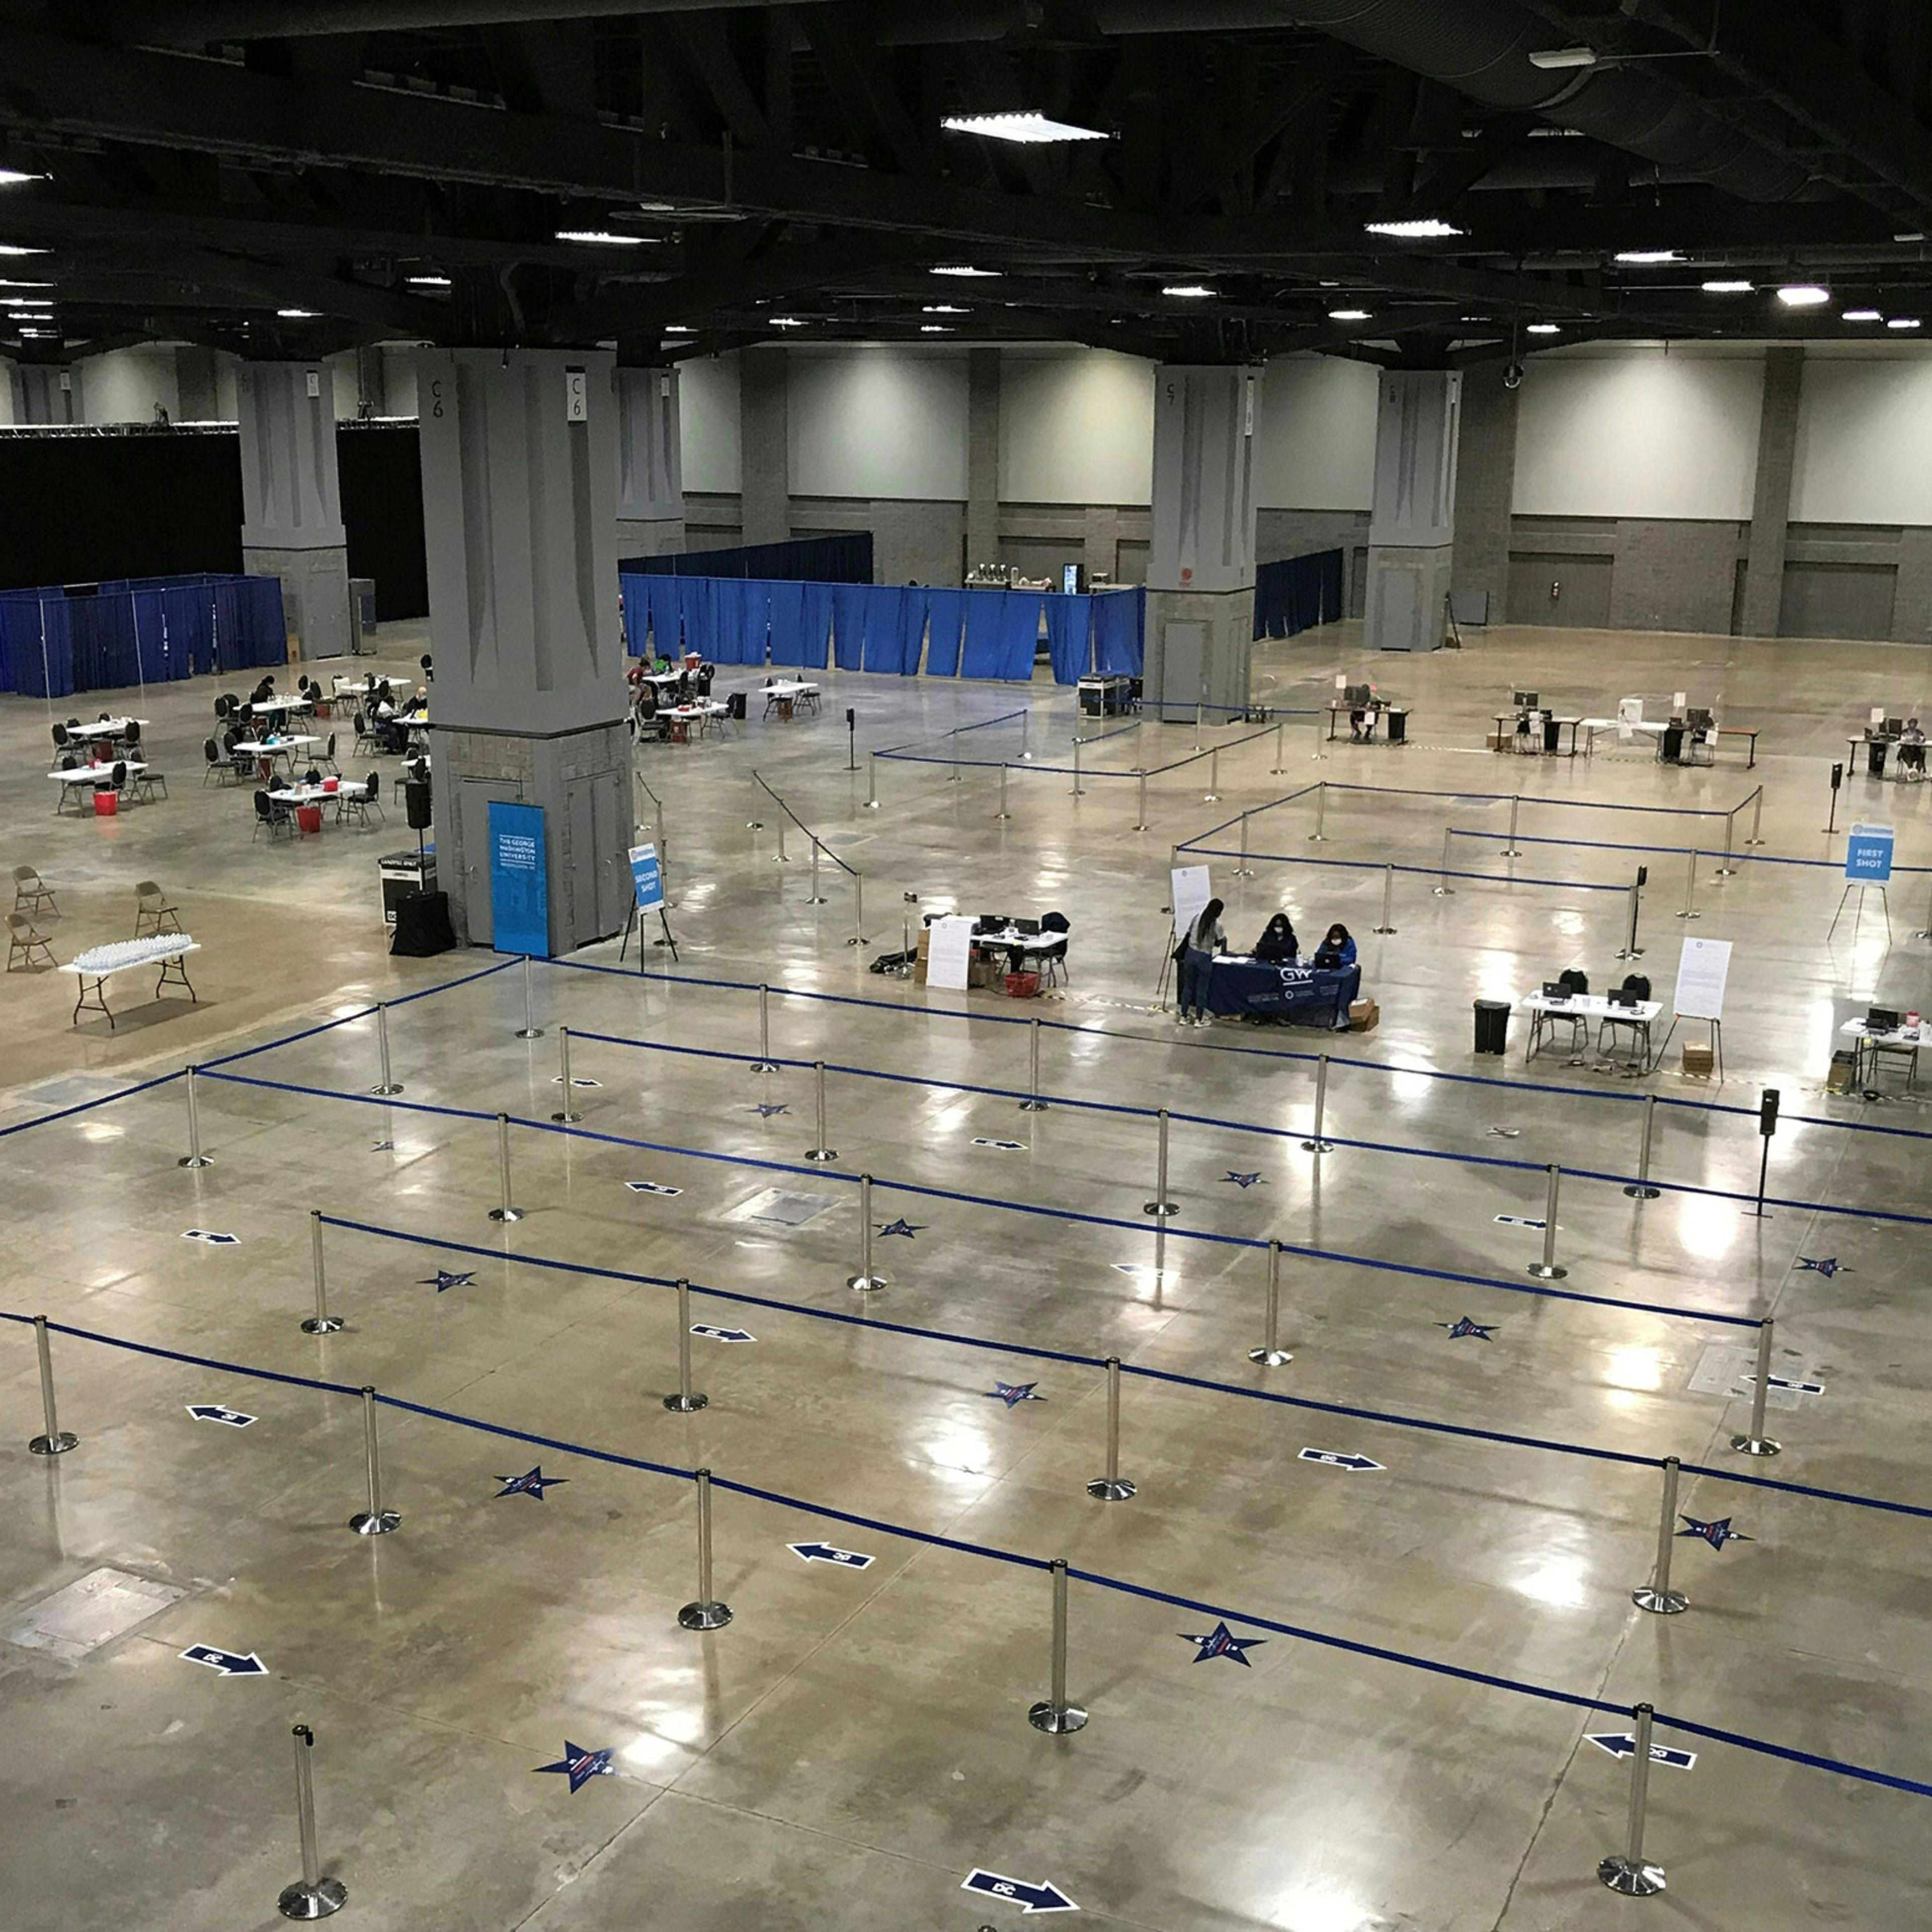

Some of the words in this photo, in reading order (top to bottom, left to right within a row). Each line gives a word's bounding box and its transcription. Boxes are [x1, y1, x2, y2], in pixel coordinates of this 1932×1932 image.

[511, 839, 535, 848] GEORGE
[499, 845, 536, 855] WASHINGTON
[1857, 849, 1884, 858] FIRST
[499, 852, 536, 861] UNIVERSITY
[1856, 859, 1882, 868] SHOT
[635, 870, 658, 883] SECOND
[641, 881, 656, 893] SHOT
[1280, 968, 1313, 982] GW
[991, 1883, 1016, 1896] DC
